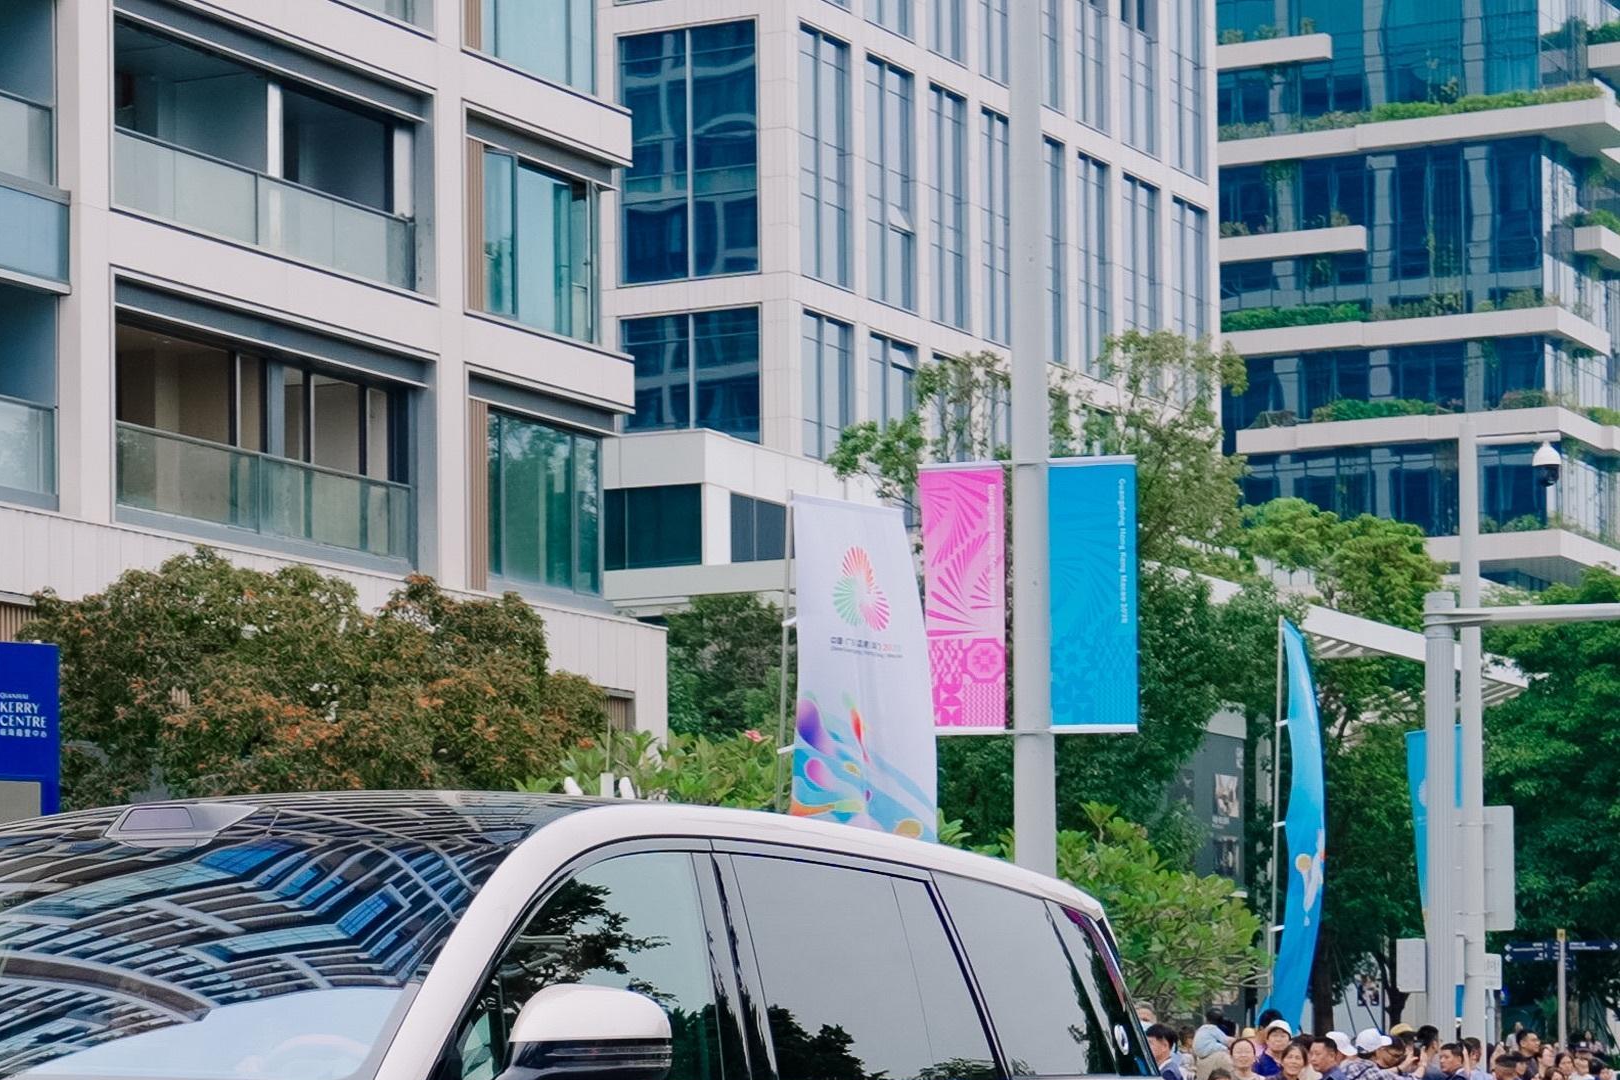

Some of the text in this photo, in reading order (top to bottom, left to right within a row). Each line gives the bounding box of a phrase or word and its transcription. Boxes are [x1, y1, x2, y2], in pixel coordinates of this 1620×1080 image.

[1117, 478, 1126, 527] Guangdong
[0, 701, 40, 714] KERRY
[0, 715, 47, 728] CENTRE
